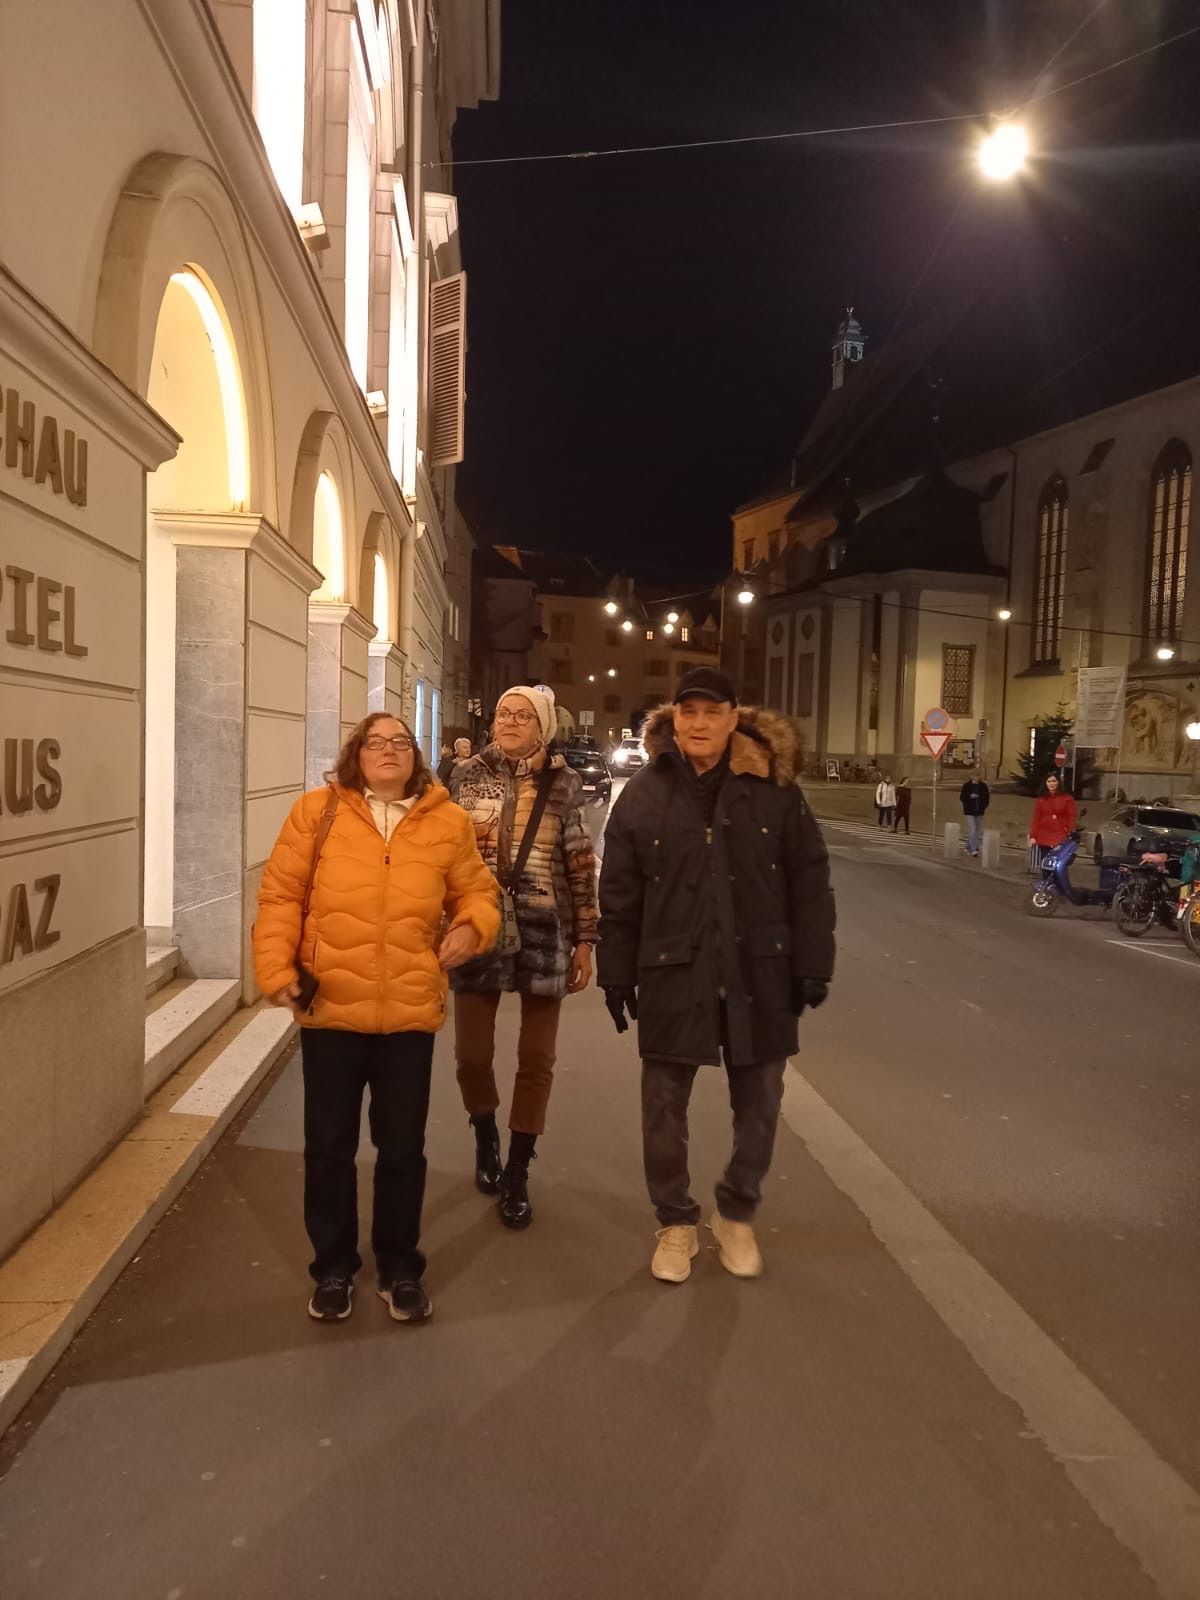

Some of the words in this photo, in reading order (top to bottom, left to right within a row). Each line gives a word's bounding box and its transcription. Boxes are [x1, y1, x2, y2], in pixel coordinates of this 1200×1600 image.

[0, 384, 88, 507] HAU
[0, 566, 88, 657] IEL
[0, 738, 62, 814] US
[0, 874, 61, 966] AZ
